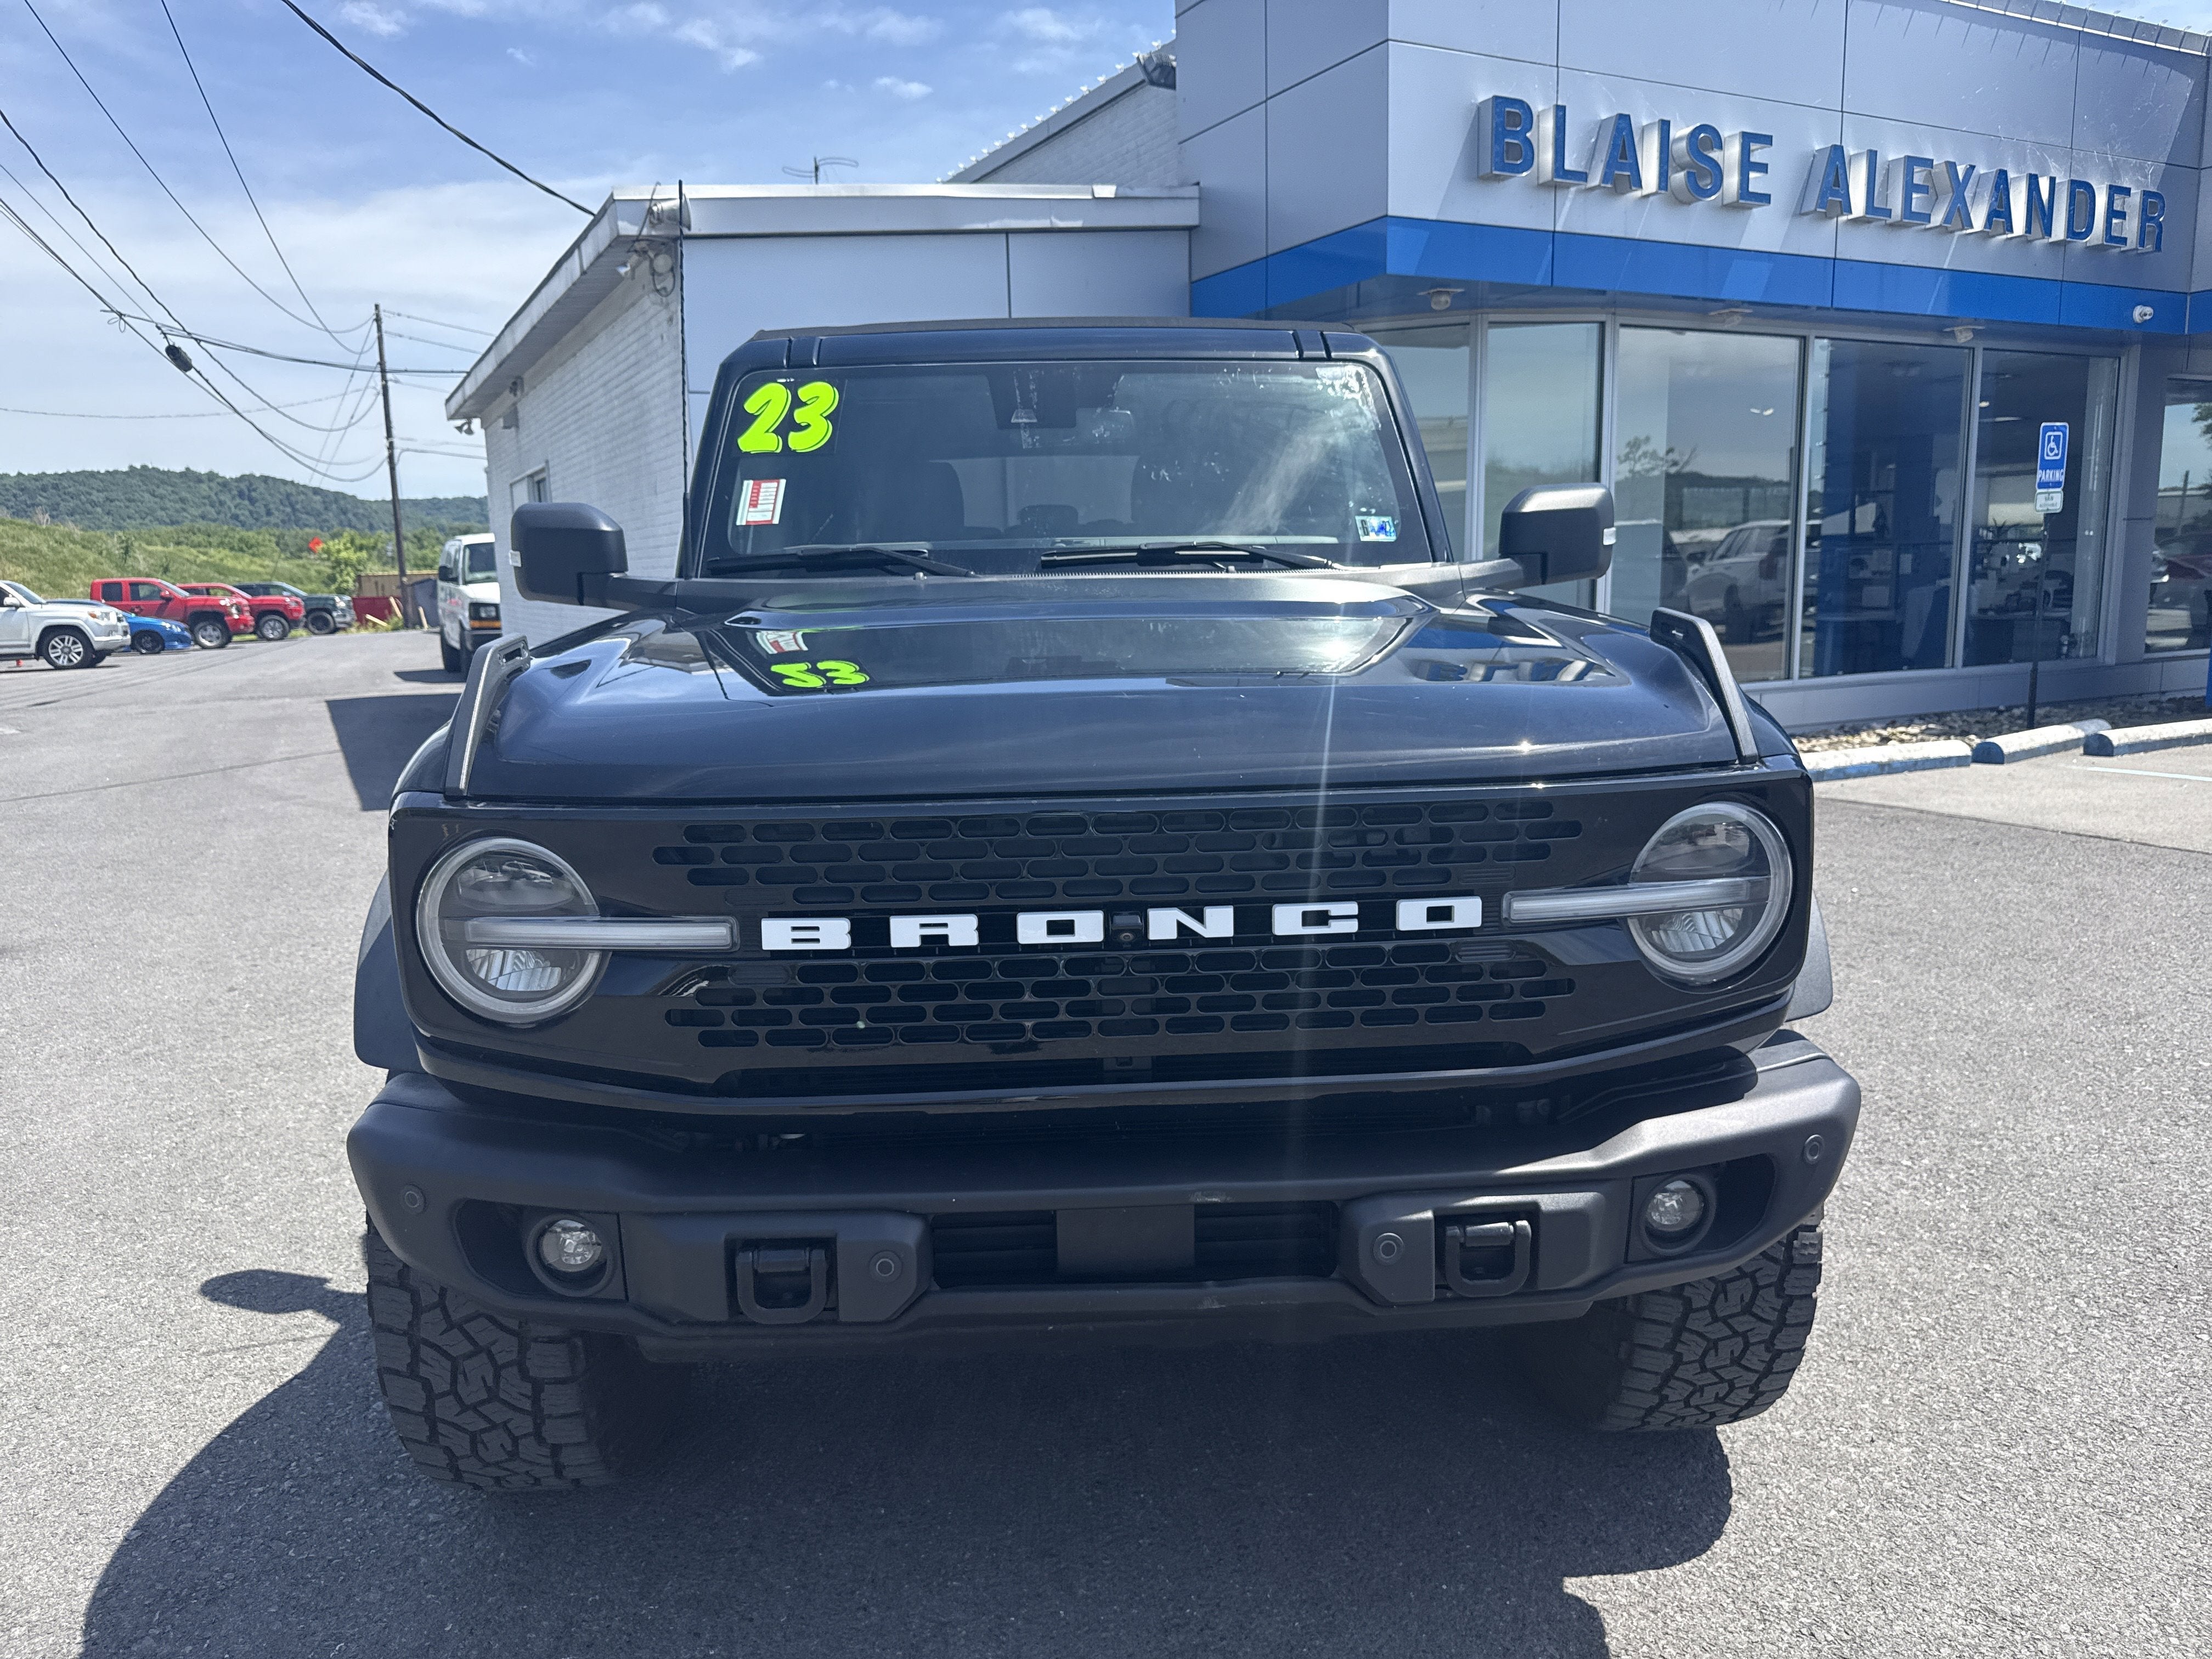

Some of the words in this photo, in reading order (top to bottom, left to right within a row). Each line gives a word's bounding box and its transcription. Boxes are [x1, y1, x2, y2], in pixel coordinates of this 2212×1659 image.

[1489, 94, 1773, 205] BLAISE
[1815, 144, 2167, 253] ALEXANDER
[737, 382, 838, 454] 23
[2038, 469, 2063, 482] PARKING
[760, 895, 1483, 951] BRONCO
